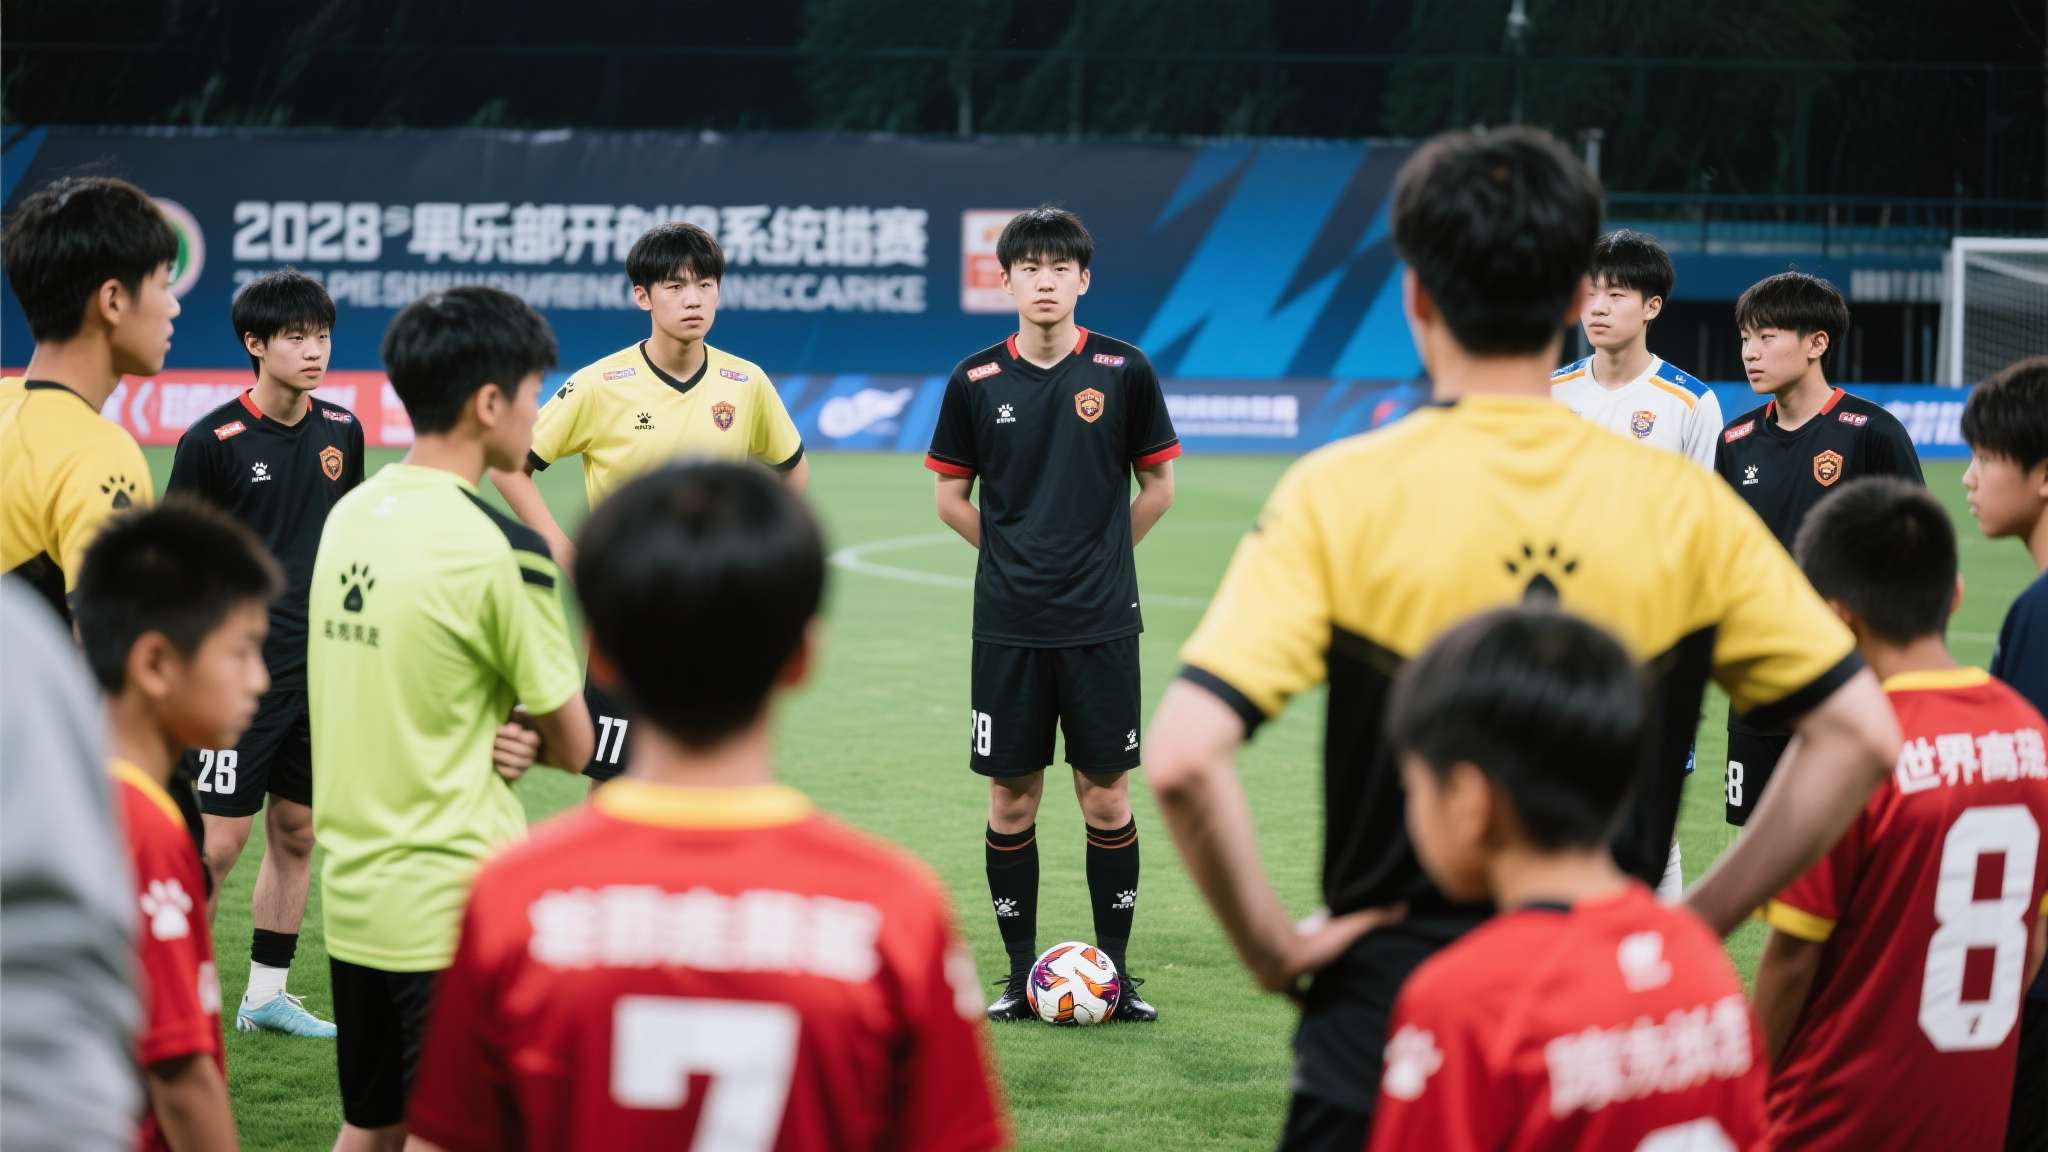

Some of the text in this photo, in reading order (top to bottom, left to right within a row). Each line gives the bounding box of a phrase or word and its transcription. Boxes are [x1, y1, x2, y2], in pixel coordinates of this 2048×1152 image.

[595, 715, 629, 764] 77
[971, 709, 992, 757] 8
[197, 748, 238, 794] 28
[1918, 803, 2040, 1052] 8
[612, 995, 800, 1152] 7
